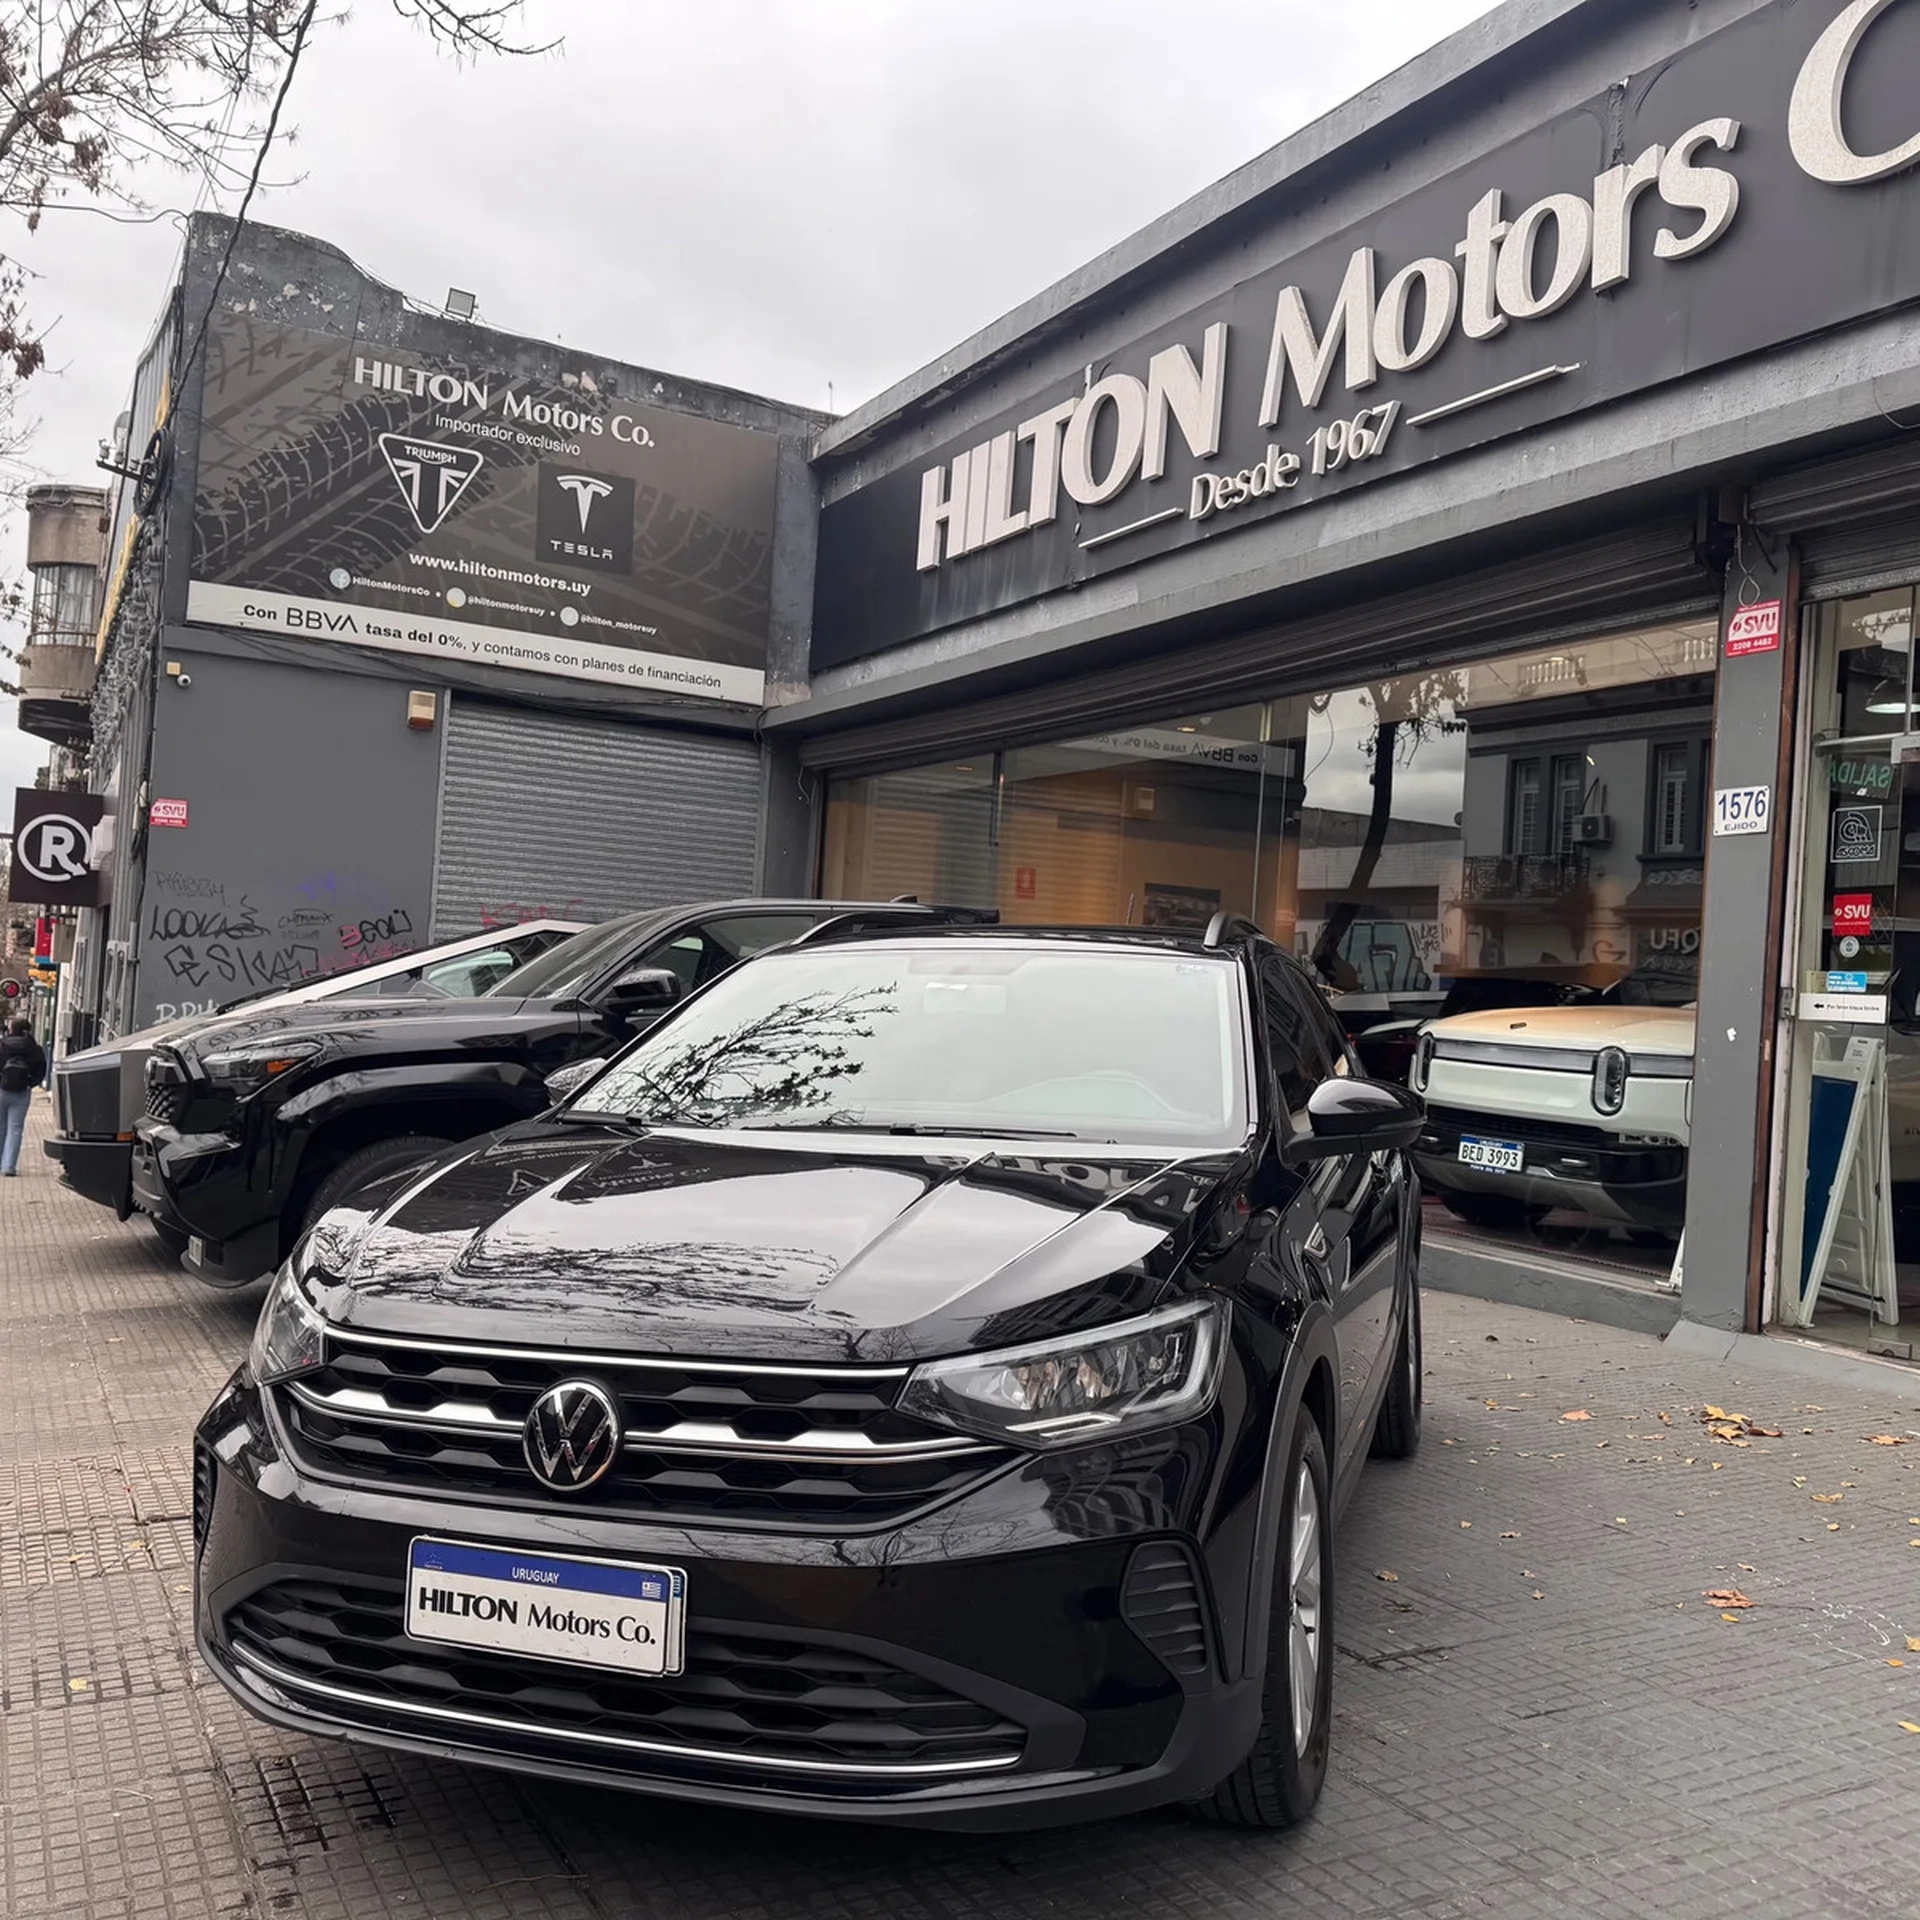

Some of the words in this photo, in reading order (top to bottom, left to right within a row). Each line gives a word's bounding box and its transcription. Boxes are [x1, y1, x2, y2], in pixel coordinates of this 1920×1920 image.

[916, 321, 1228, 571] HILTON
[1258, 118, 1742, 428] Motors
[353, 357, 488, 411] HILTON
[502, 390, 604, 436] Motors
[610, 414, 656, 448] Co.
[435, 413, 514, 442] Importador
[516, 430, 581, 456] exclusivo
[404, 445, 457, 465] TRIUMPH
[1189, 444, 1300, 521] Desde
[1306, 400, 1402, 475] 1967
[551, 540, 613, 561] TESLA
[352, 576, 431, 597] HiltonMotorsCo
[409, 553, 592, 598] www.hiltonmotors.uy
[1744, 612, 1776, 634] SVU
[243, 604, 278, 621] Con
[285, 607, 359, 634] BBVA
[365, 622, 403, 640] tasa
[407, 629, 433, 644] del
[438, 631, 467, 650] 0%,
[471, 640, 481, 653] y
[483, 640, 551, 662] contamos
[553, 653, 579, 667] con
[582, 655, 625, 673] planes
[627, 663, 645, 677] de
[647, 662, 722, 689] financiación
[161, 805, 185, 816] SVU
[1718, 790, 1766, 820] 1576
[1724, 820, 1758, 831] EJIDO
[1843, 904, 1870, 919] SVU
[1462, 1144, 1484, 1162] BED
[1487, 1148, 1519, 1168] 3993
[511, 1566, 560, 1584] URUGUAY
[418, 1586, 518, 1625] HILTON
[527, 1602, 611, 1639] Motors
[616, 1615, 657, 1646] Co.
